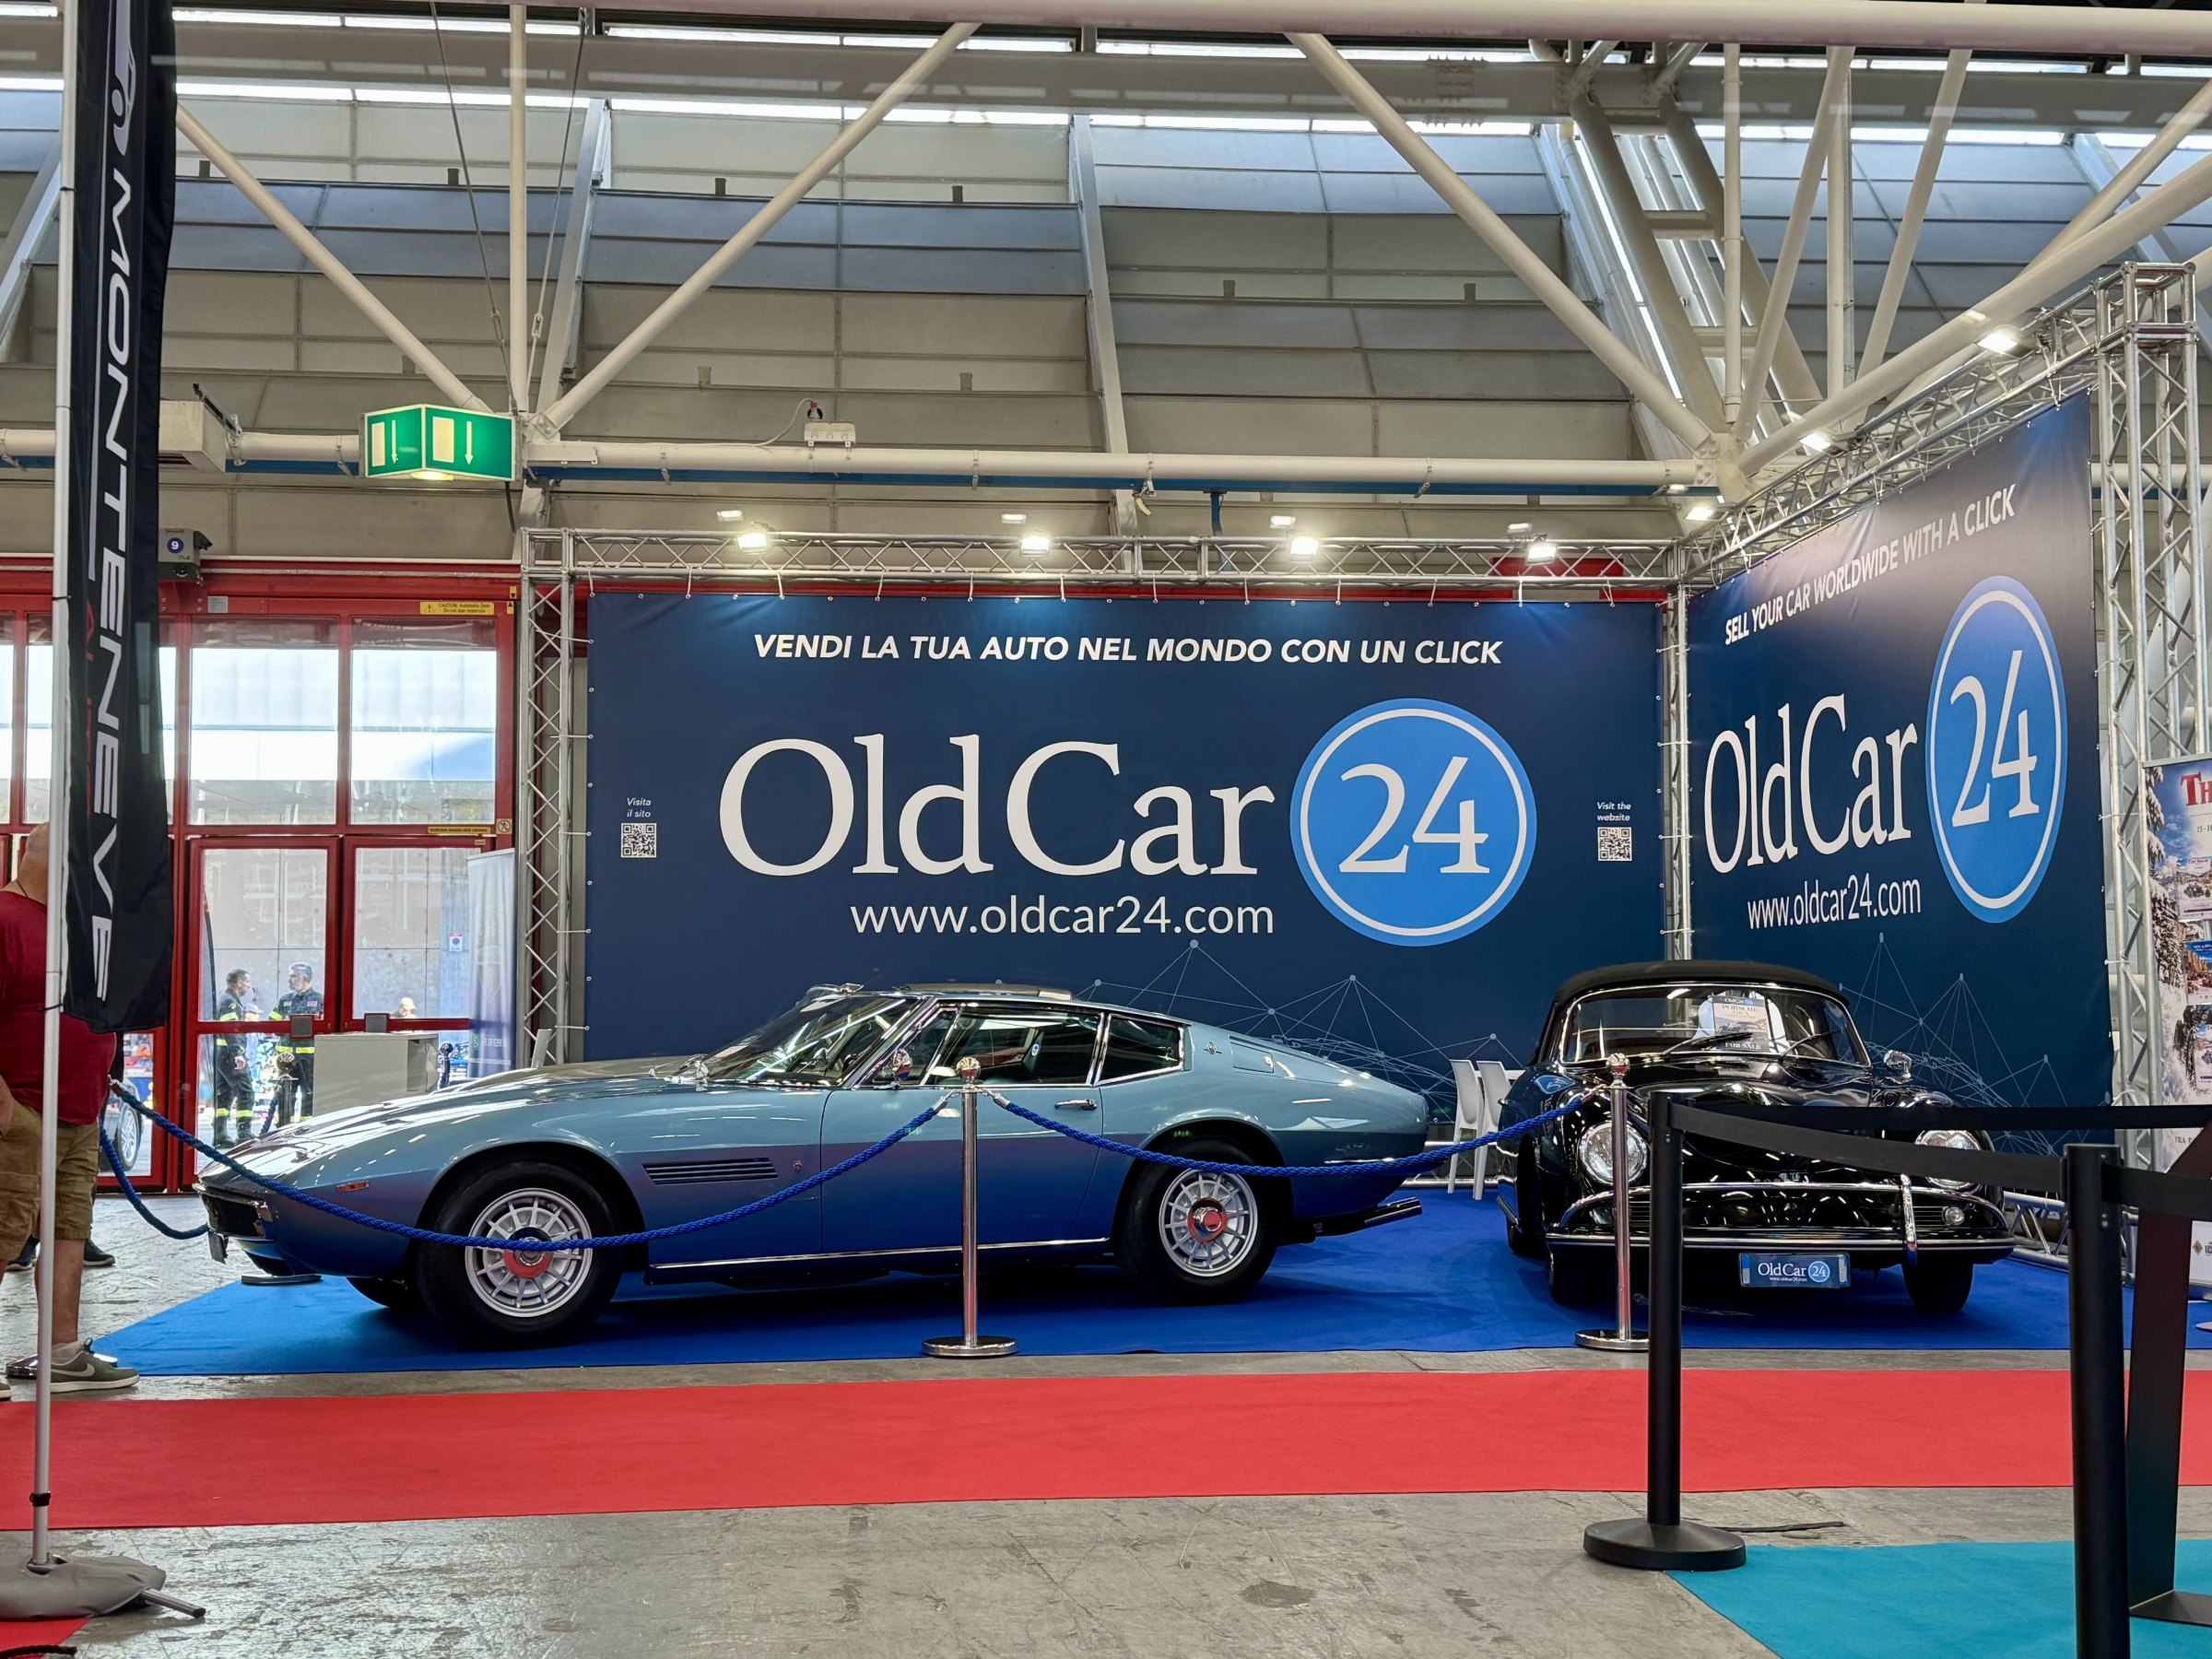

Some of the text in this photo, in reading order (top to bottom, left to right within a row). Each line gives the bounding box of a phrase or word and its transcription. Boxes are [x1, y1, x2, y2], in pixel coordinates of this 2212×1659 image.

[171, 540, 180, 550] 9
[1725, 483, 2016, 645] SELL YOUR CAR WORLDWIDE WITH A CLICK
[92, 168, 131, 1001] MONTENEVE
[754, 634, 1504, 665] VENDI LA TUA AUTO NEL MONDO CON UN CLICK
[1704, 650, 2041, 874] OldCar 24
[627, 797, 652, 806] Visita
[627, 808, 652, 818] il sito
[719, 733, 1491, 877] OldCar 24
[1596, 801, 1632, 810] Visit the
[1596, 812, 1630, 821] website
[850, 894, 1274, 935] www.oldcar24.com
[1747, 872, 1922, 930] www.oldcar24.com
[1758, 1262, 1827, 1277] OldCar 24
